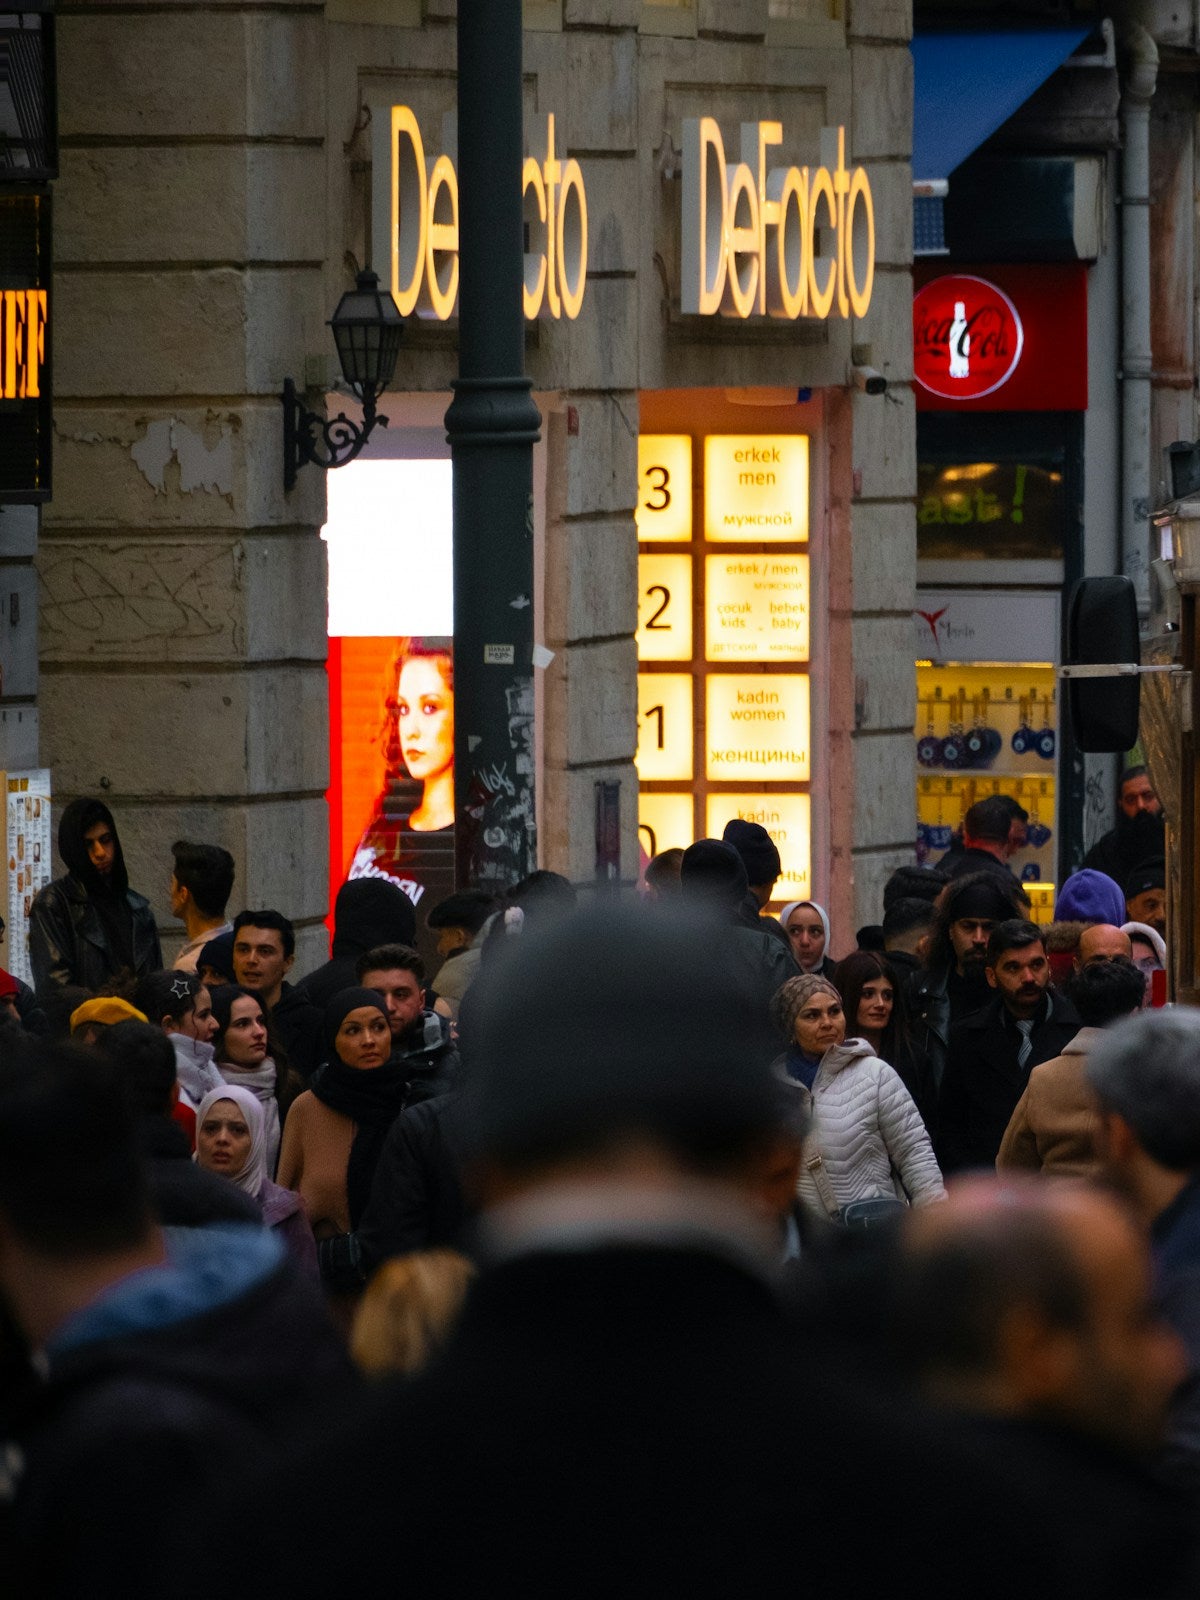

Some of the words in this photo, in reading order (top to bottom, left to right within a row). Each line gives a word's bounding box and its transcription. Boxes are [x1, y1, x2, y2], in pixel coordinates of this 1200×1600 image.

[391, 105, 588, 321] Decto
[699, 116, 876, 320] DeFacto
[0, 289, 48, 399] EF
[734, 446, 781, 464] erkek
[739, 471, 776, 486] men
[645, 466, 671, 511] 3
[723, 513, 792, 529] мужской
[726, 562, 760, 575] erkek
[772, 564, 798, 576] men
[645, 586, 672, 629] 2
[769, 602, 806, 614] bebek
[721, 617, 746, 629] kids
[771, 617, 801, 631] baby
[737, 690, 779, 704] kadın
[730, 709, 786, 721] women
[645, 704, 664, 750] 1
[711, 750, 805, 766] женщины
